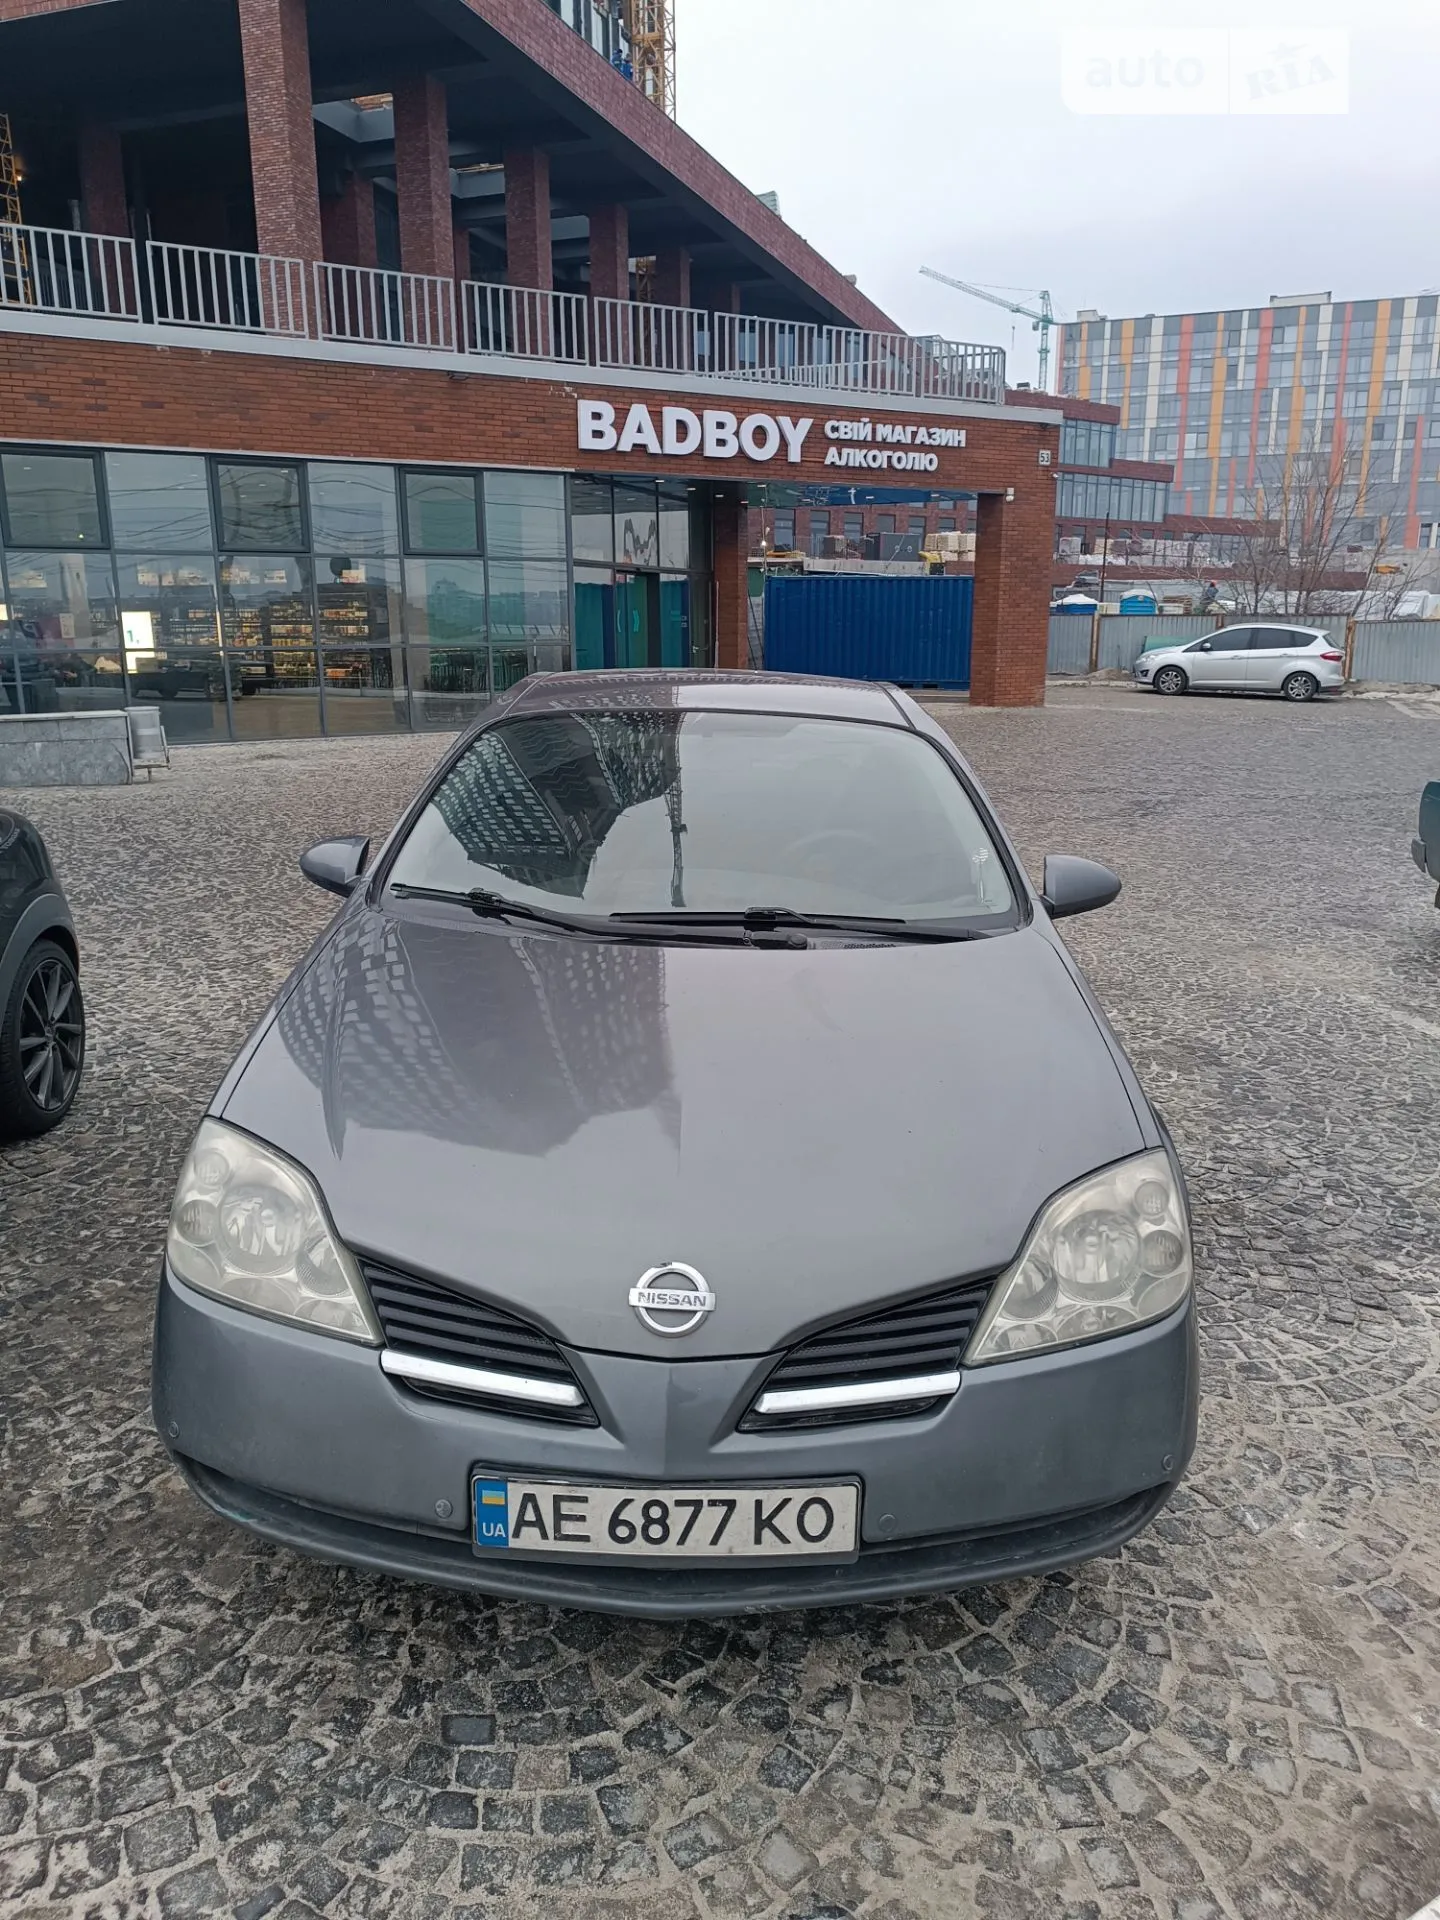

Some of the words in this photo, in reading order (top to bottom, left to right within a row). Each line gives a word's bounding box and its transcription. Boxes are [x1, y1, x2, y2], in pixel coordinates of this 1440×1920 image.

[577, 400, 813, 463] BADBOY
[824, 418, 872, 441] СВІЙ
[876, 424, 967, 447] МАГАЗИН
[824, 447, 939, 472] АЛКОГОЛЮ
[1040, 452, 1049, 463] 53
[638, 1292, 706, 1307] NISSAN
[482, 1522, 506, 1538] UA
[512, 1492, 590, 1541] AE
[608, 1498, 737, 1546] 6877
[753, 1497, 835, 1546] KO
